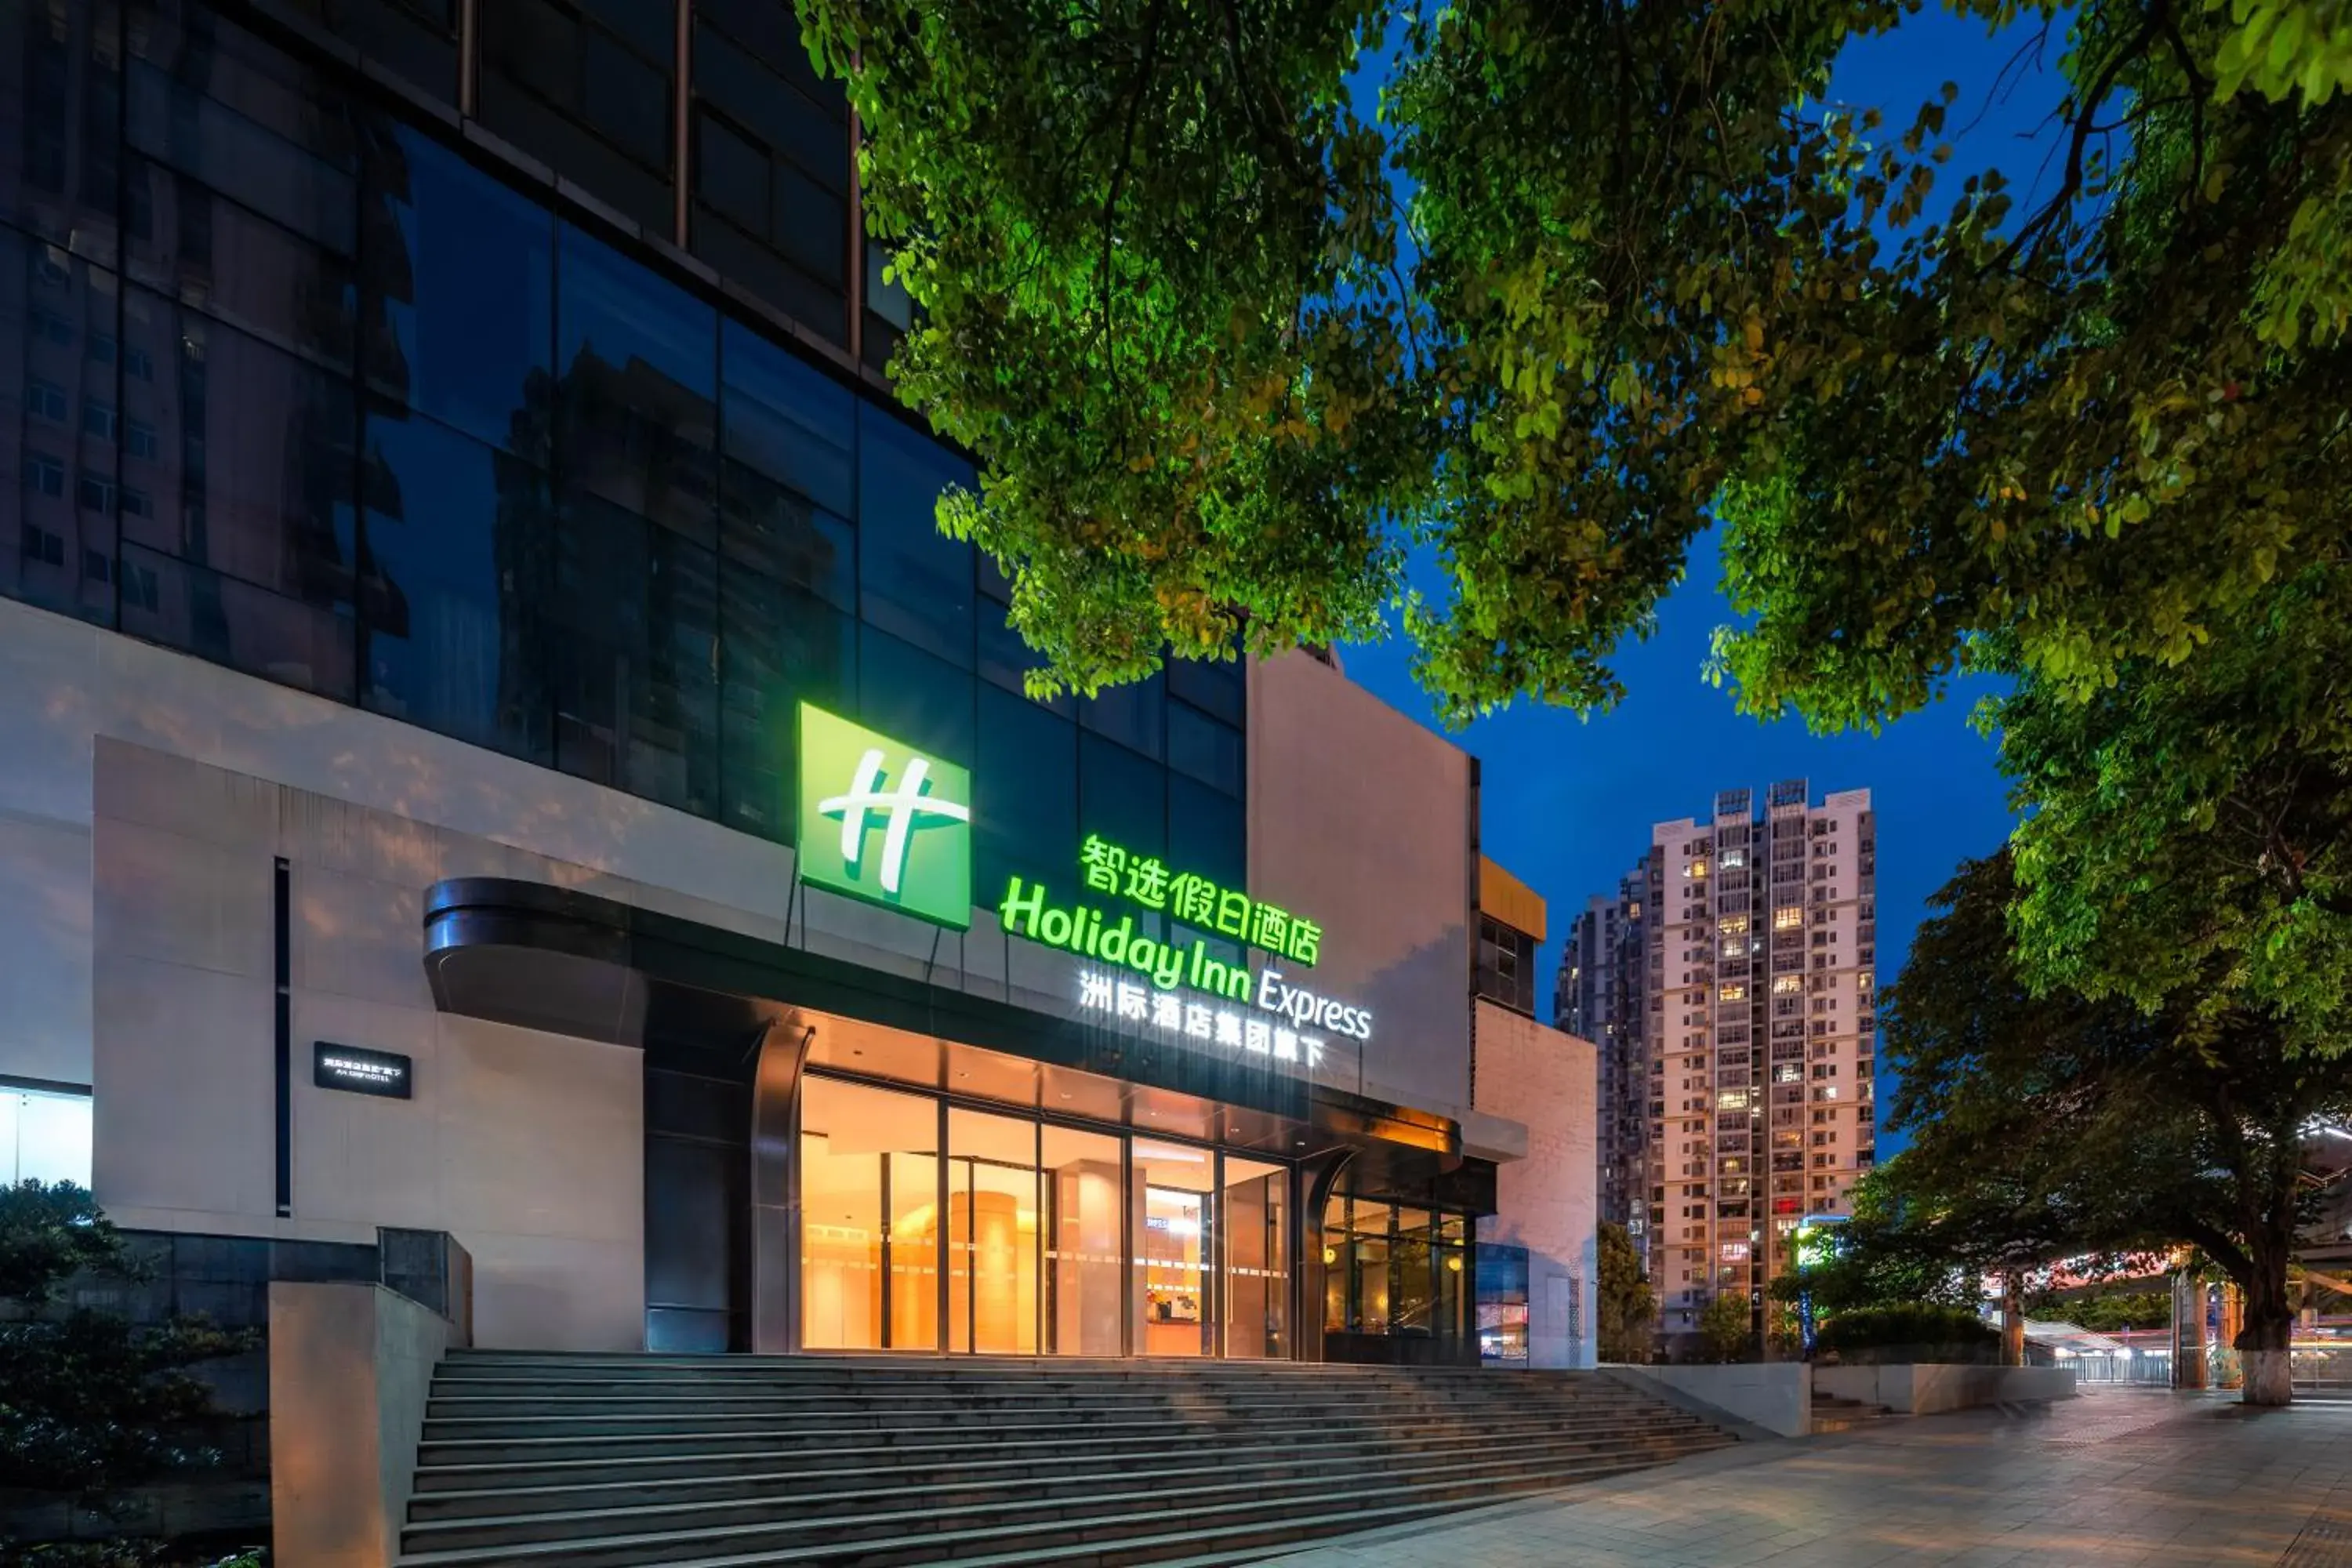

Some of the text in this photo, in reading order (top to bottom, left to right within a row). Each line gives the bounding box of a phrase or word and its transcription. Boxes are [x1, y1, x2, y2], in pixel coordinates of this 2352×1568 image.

[1000, 876, 1371, 1040] Holiday Inn Express
[1081, 833, 1322, 966] 智选假日酒店
